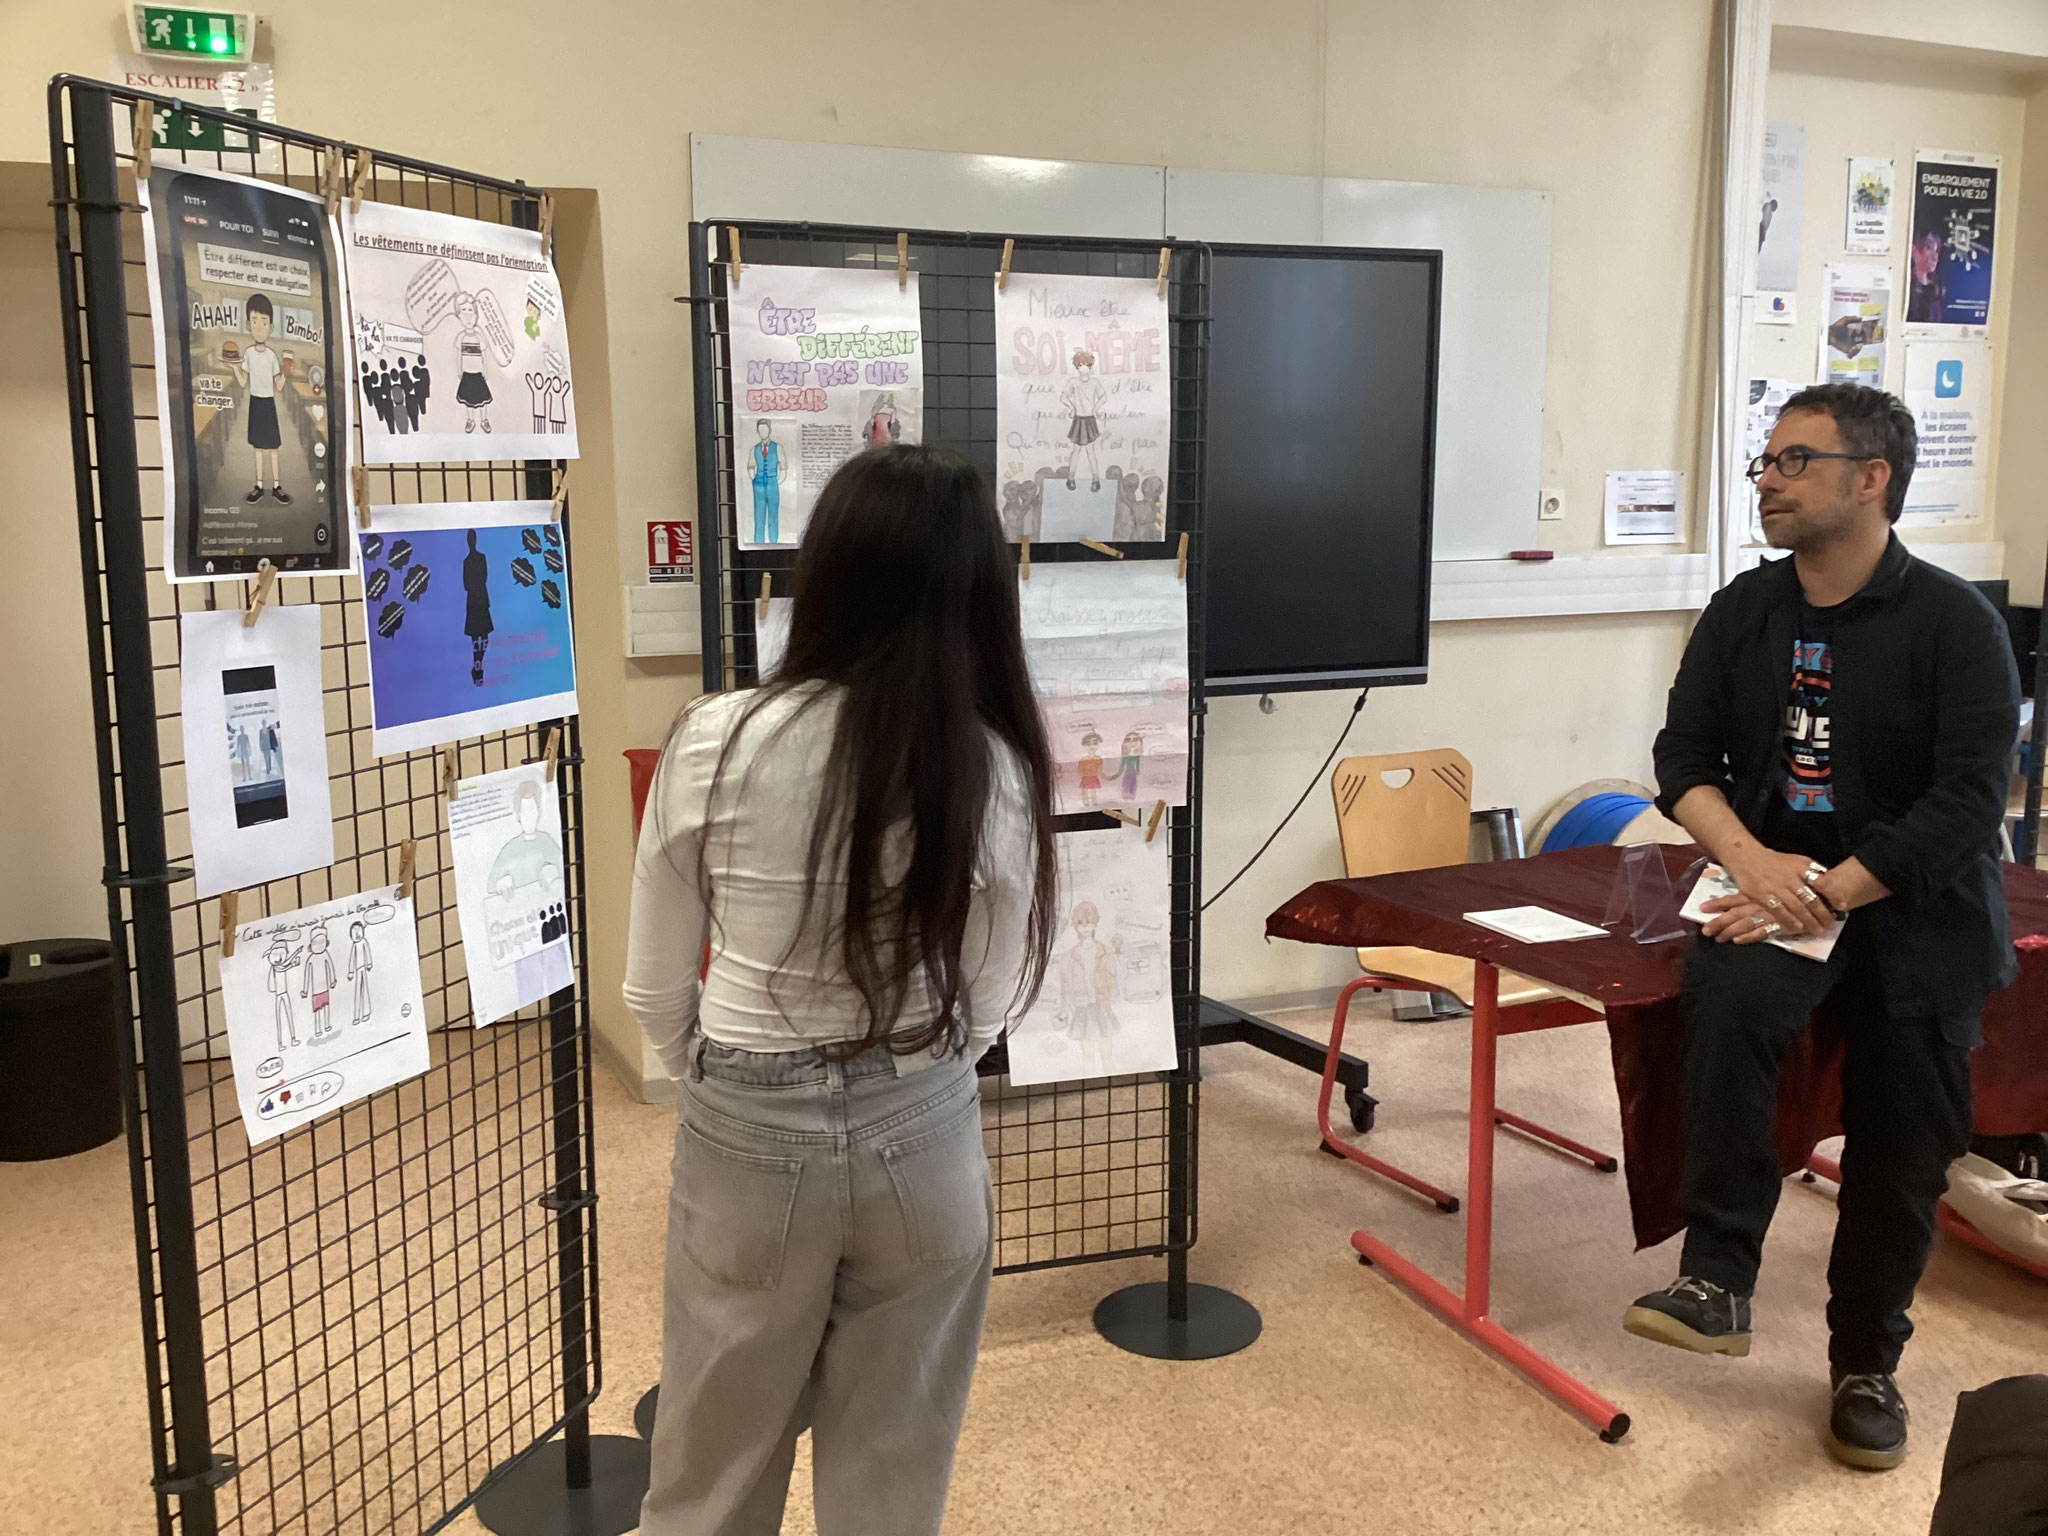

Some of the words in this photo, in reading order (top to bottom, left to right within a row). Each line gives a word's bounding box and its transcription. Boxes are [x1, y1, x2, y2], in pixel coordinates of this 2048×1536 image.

[125, 72, 218, 91] ESCALIER
[1922, 173, 1991, 188] EMBARQUEMENT
[1924, 185, 1947, 196] POUR
[1948, 187, 1960, 198] LA
[1961, 188, 1974, 199] VIE
[219, 220, 240, 232] POUR
[353, 232, 370, 246] Les
[371, 234, 425, 253] vêtements
[426, 243, 438, 255] ne
[440, 243, 485, 261] définissent
[486, 252, 500, 265] pas
[500, 253, 548, 271] l'orientation
[206, 266, 245, 281] respecter
[246, 274, 259, 284] est
[260, 276, 274, 286] une
[265, 262, 278, 271] est
[1028, 288, 1090, 318] Mieux
[1099, 299, 1131, 317] être
[192, 303, 238, 328] AHAH!
[758, 297, 817, 336] ÊTRE
[746, 358, 811, 387] N'EST
[814, 360, 859, 388] PAS
[864, 360, 909, 387] UNE
[745, 388, 829, 413] ERREUR
